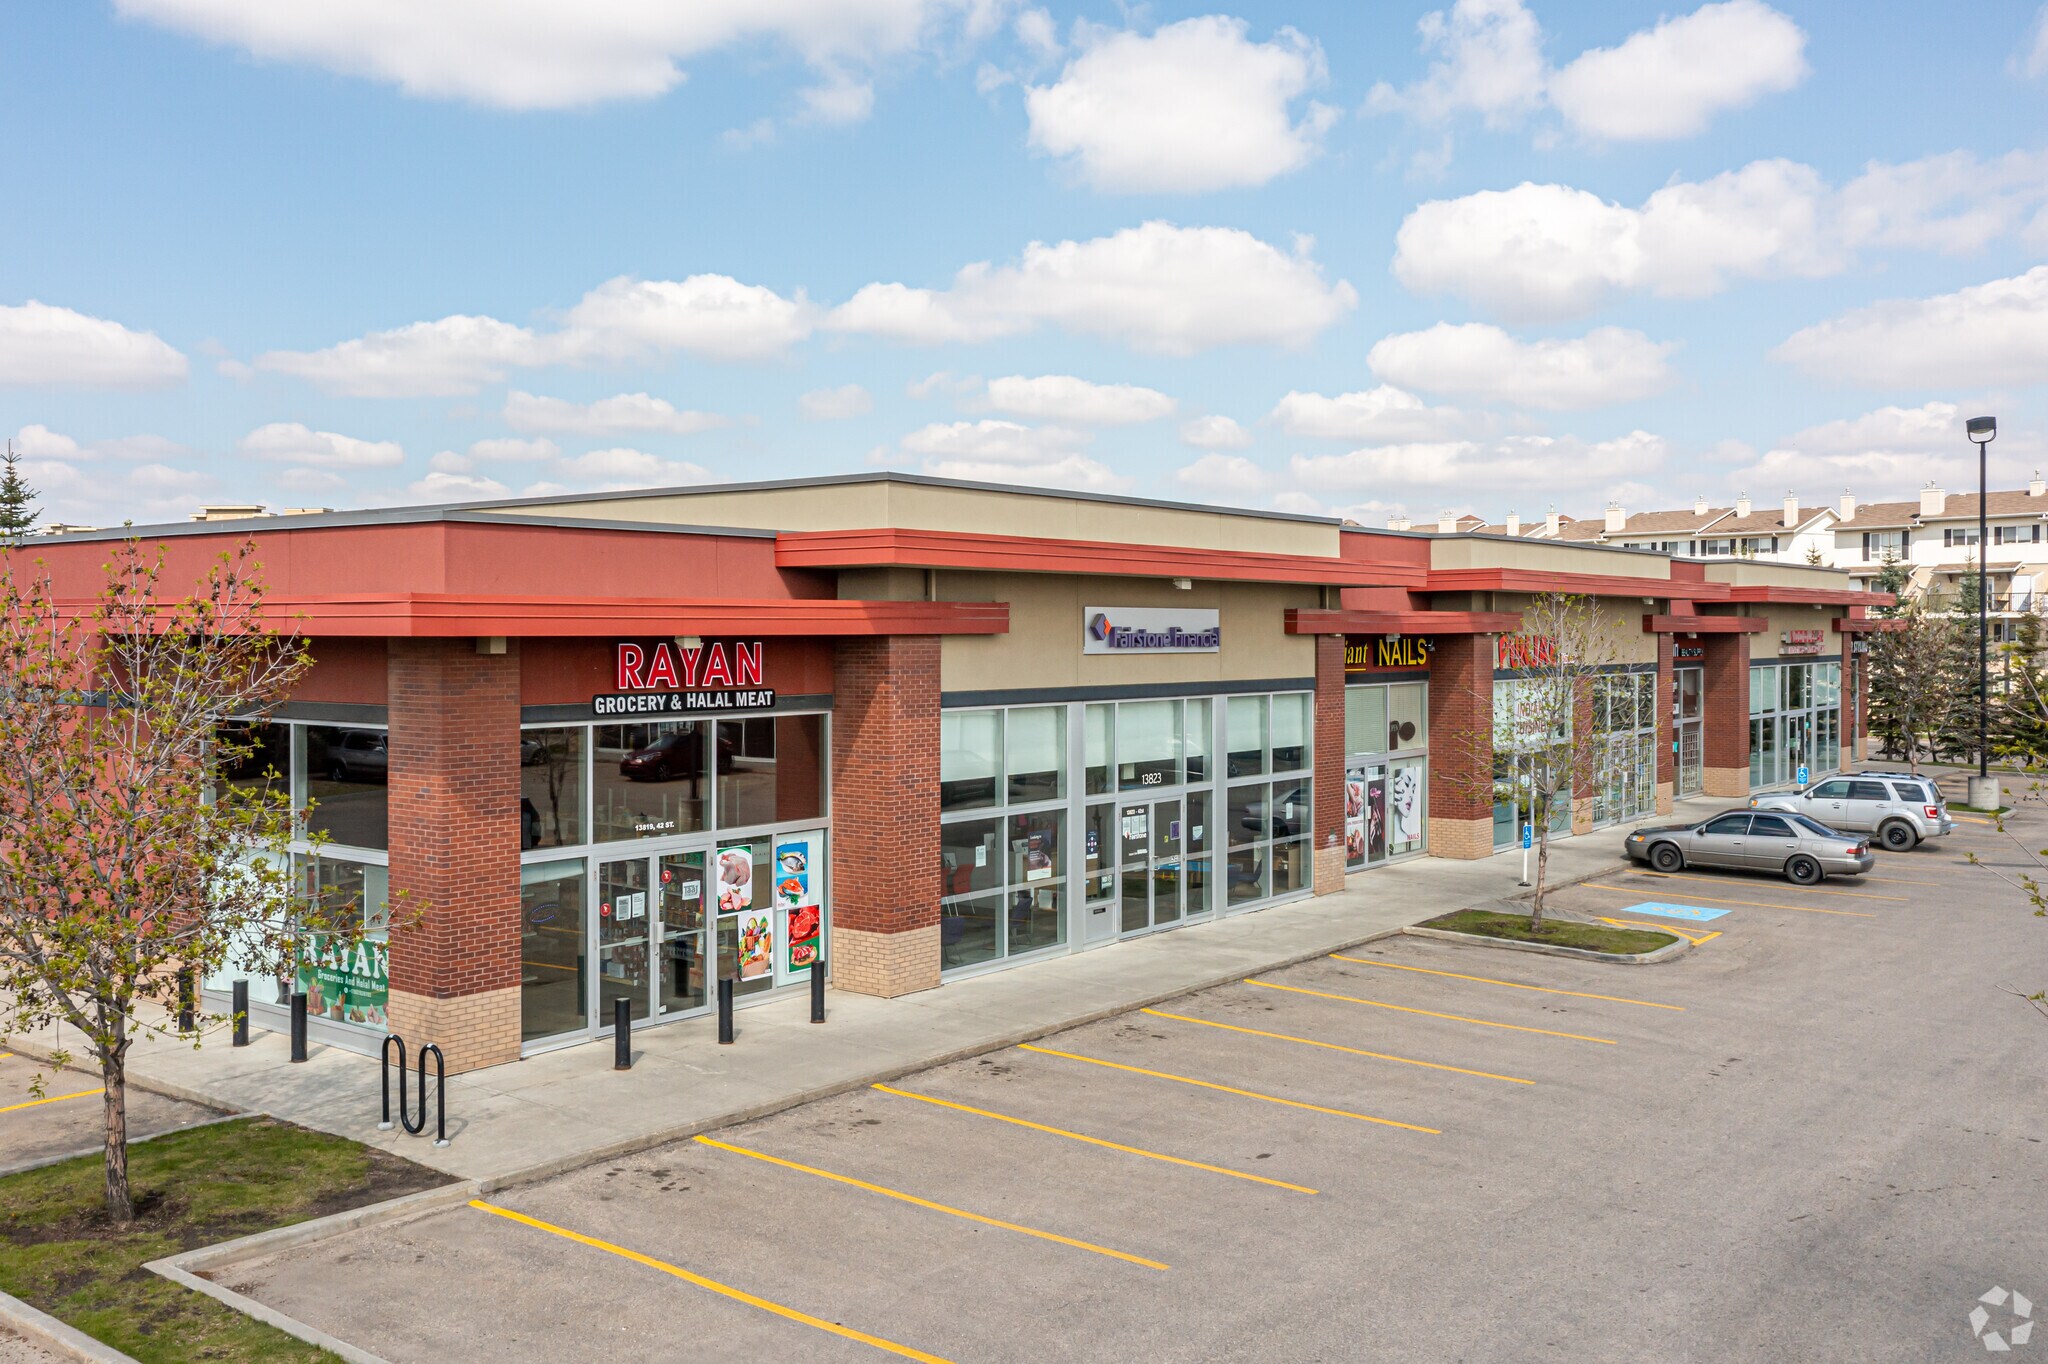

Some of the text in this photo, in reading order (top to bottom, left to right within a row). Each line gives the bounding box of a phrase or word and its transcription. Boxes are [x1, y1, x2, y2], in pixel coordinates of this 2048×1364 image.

[1109, 626, 1170, 648] Fairstone
[1344, 638, 1427, 667] iant NAILS
[617, 642, 763, 690] RAYAN
[595, 690, 773, 714] GROCERY & HALAL MEAT
[1141, 772, 1162, 785] 13823
[1406, 832, 1420, 841] NAILS
[344, 975, 355, 986] And
[371, 980, 385, 992] Meat
